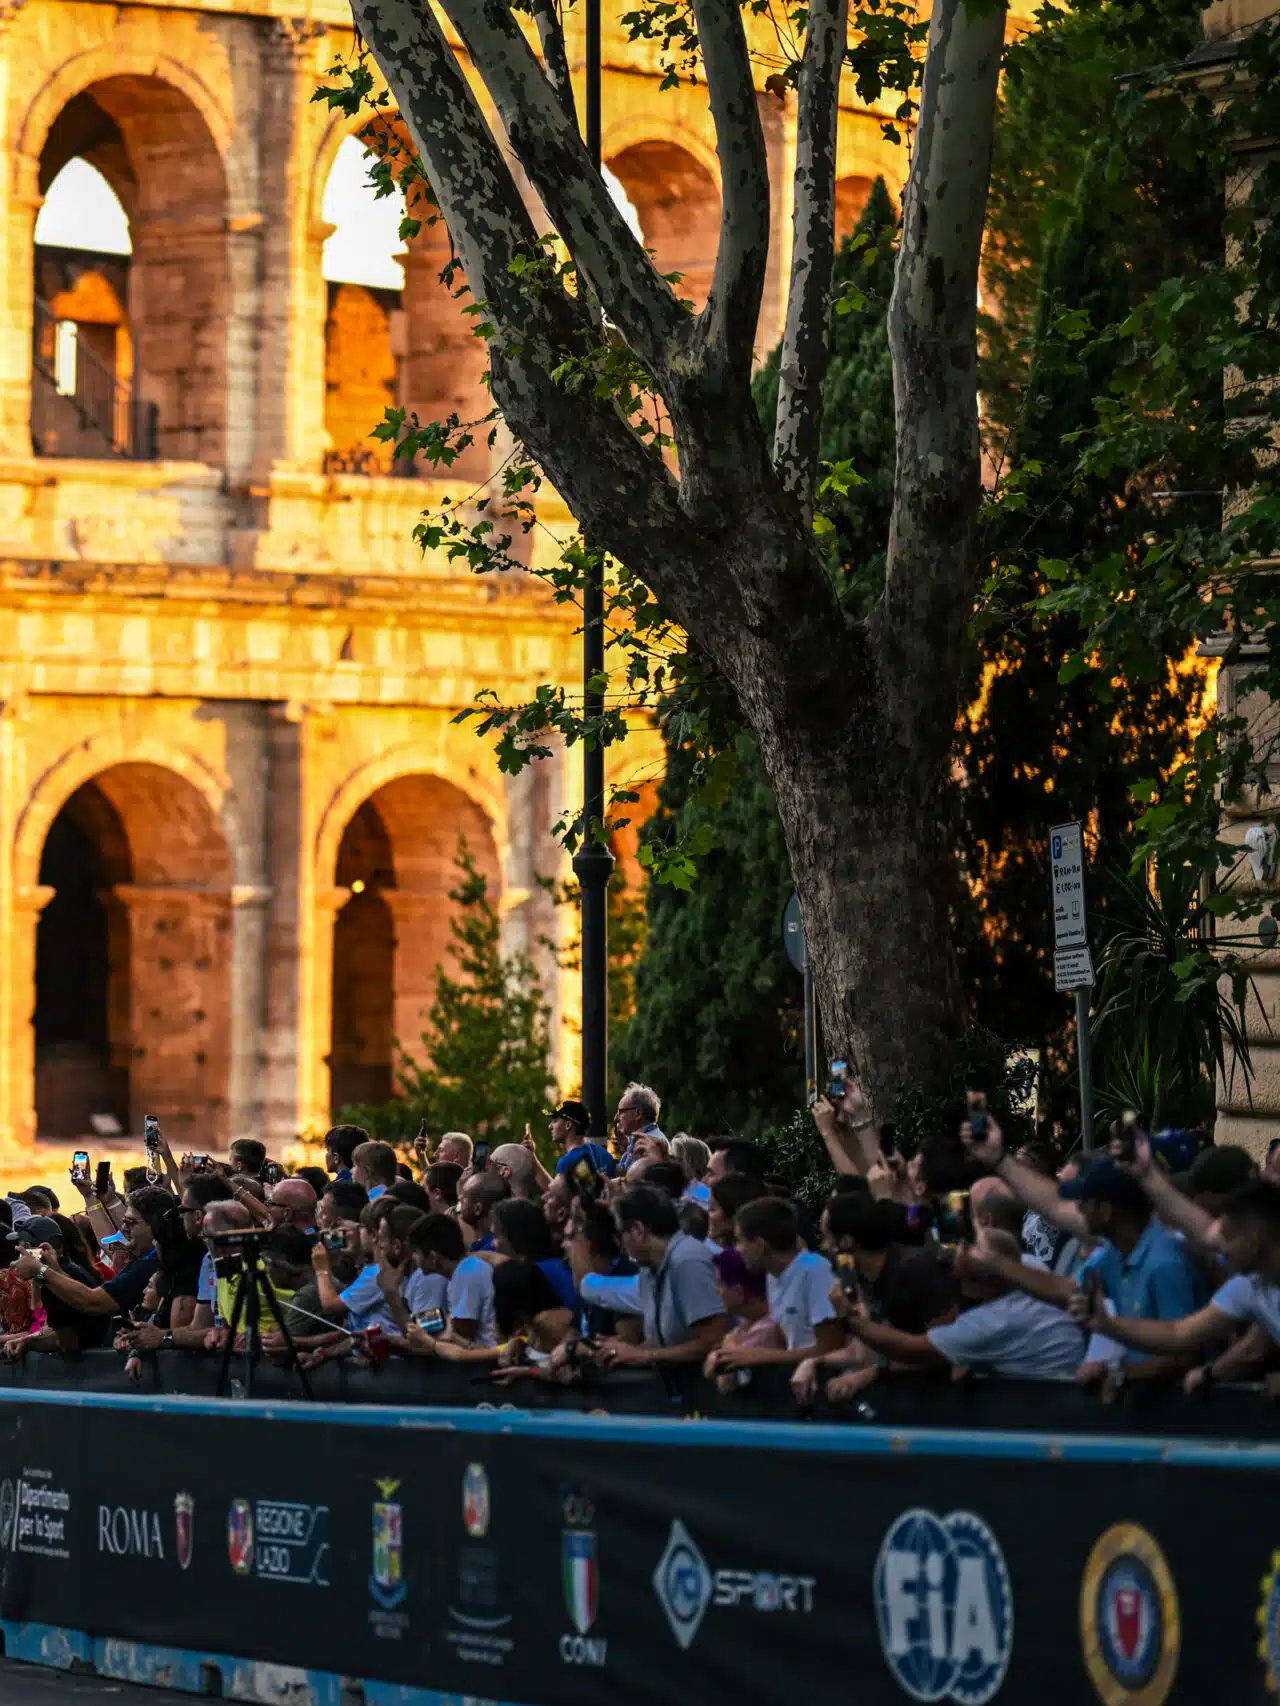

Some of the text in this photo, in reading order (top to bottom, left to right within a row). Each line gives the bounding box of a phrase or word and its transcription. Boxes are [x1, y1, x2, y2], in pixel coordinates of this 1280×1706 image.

[98, 1505, 165, 1559] ROMA
[716, 1568, 817, 1613] SPORT
[560, 1633, 608, 1668] CONI
